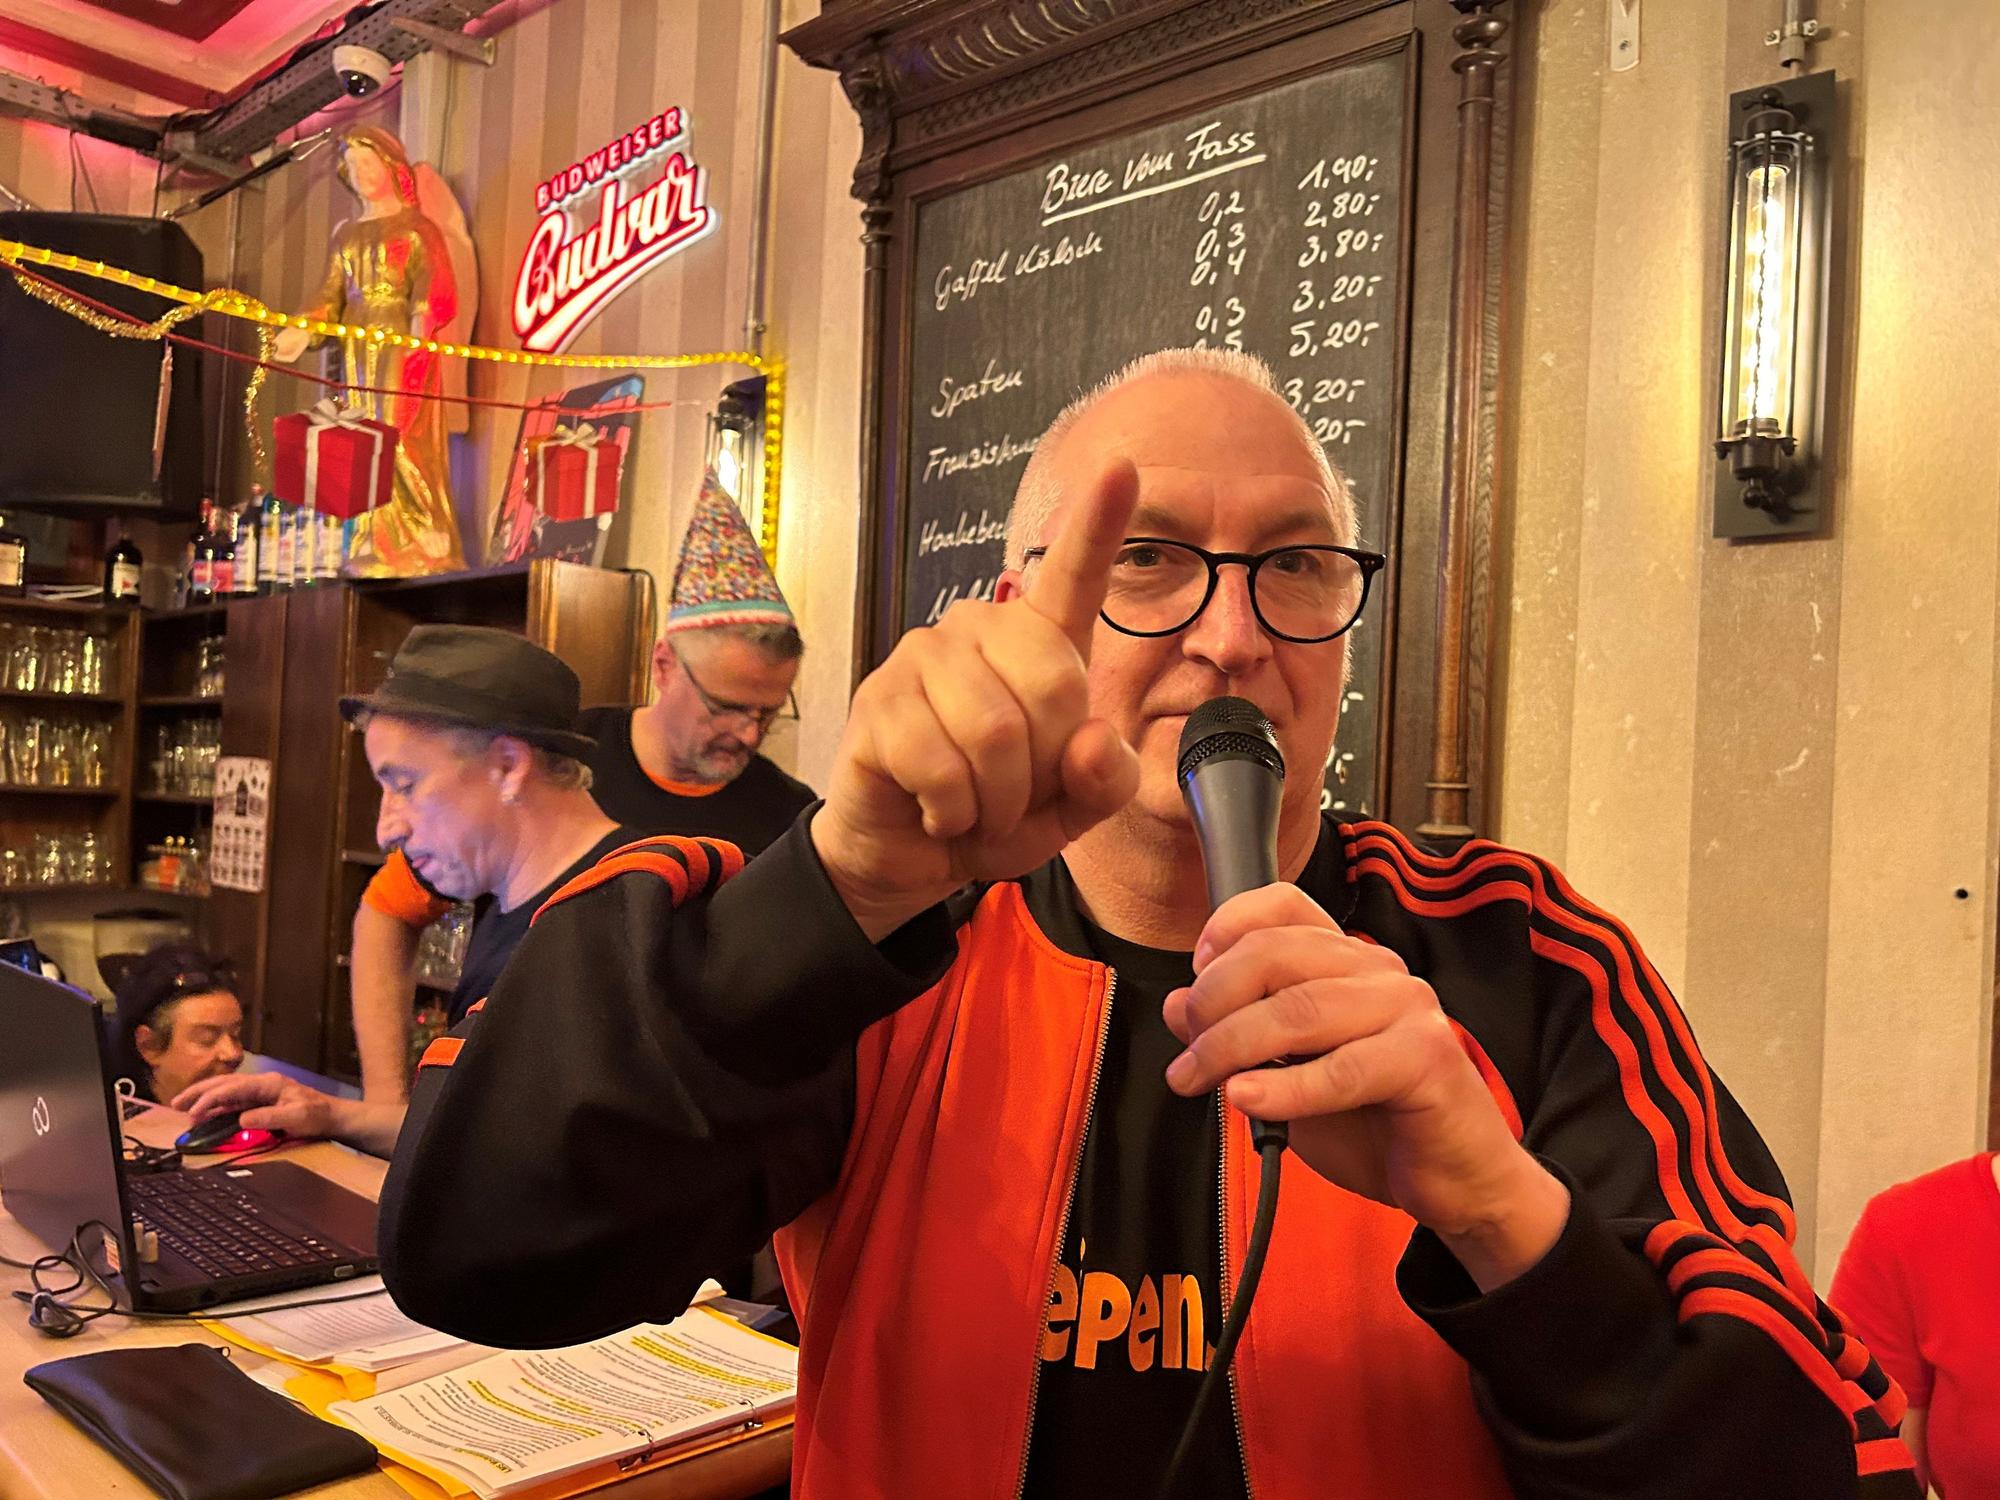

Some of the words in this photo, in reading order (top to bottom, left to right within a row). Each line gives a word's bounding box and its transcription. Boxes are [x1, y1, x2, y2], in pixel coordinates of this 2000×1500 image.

[536, 106, 681, 214] BUDWEISER
[1040, 162, 1115, 215] Biere
[1185, 121, 1257, 171] Fass
[512, 152, 708, 339] Budvar
[1014, 231, 1104, 276] Kölsch
[1197, 190, 1246, 227] 0,2
[1189, 248, 1247, 287] 0,4
[1194, 222, 1247, 264] 0,3
[1195, 297, 1247, 334] 0,3
[930, 357, 1024, 418] Spaten
